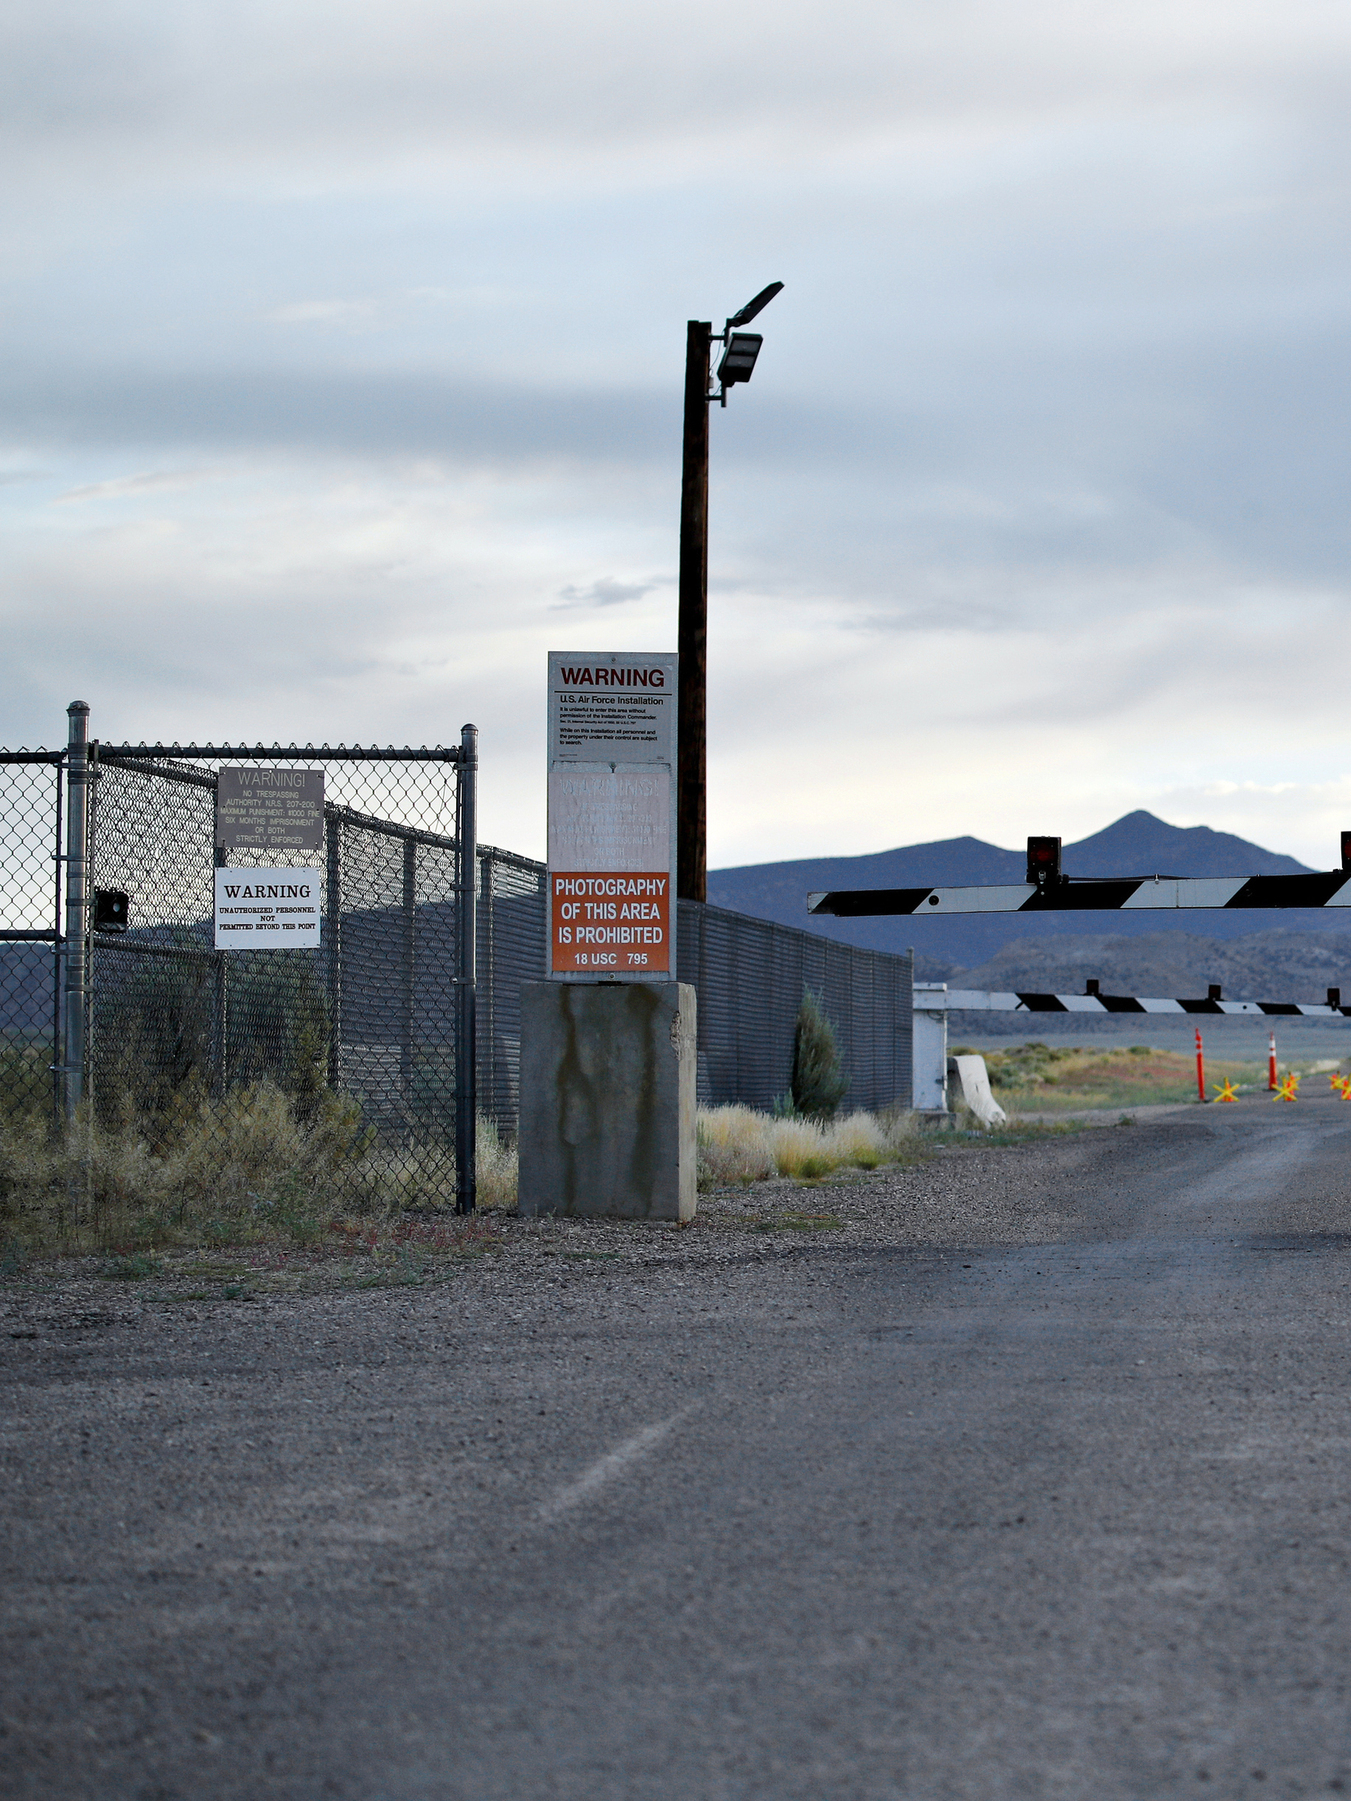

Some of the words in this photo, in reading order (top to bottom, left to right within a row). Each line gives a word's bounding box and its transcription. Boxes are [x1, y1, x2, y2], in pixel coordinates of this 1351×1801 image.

[560, 668, 664, 687] WARNING
[560, 695, 576, 703] U.S.
[592, 696, 616, 704] Force
[618, 697, 664, 705] Installation
[238, 772, 306, 787] WARNING!
[224, 885, 311, 898] WARNING
[556, 879, 666, 895] PHOTOGRAPHY
[561, 903, 580, 919] OF
[585, 903, 617, 920] THIS
[620, 903, 660, 919] AREA
[559, 927, 572, 944] IS
[576, 927, 663, 944] PROHIBITED
[574, 953, 588, 965] 18
[591, 953, 617, 965] USC
[627, 953, 648, 965] 795
